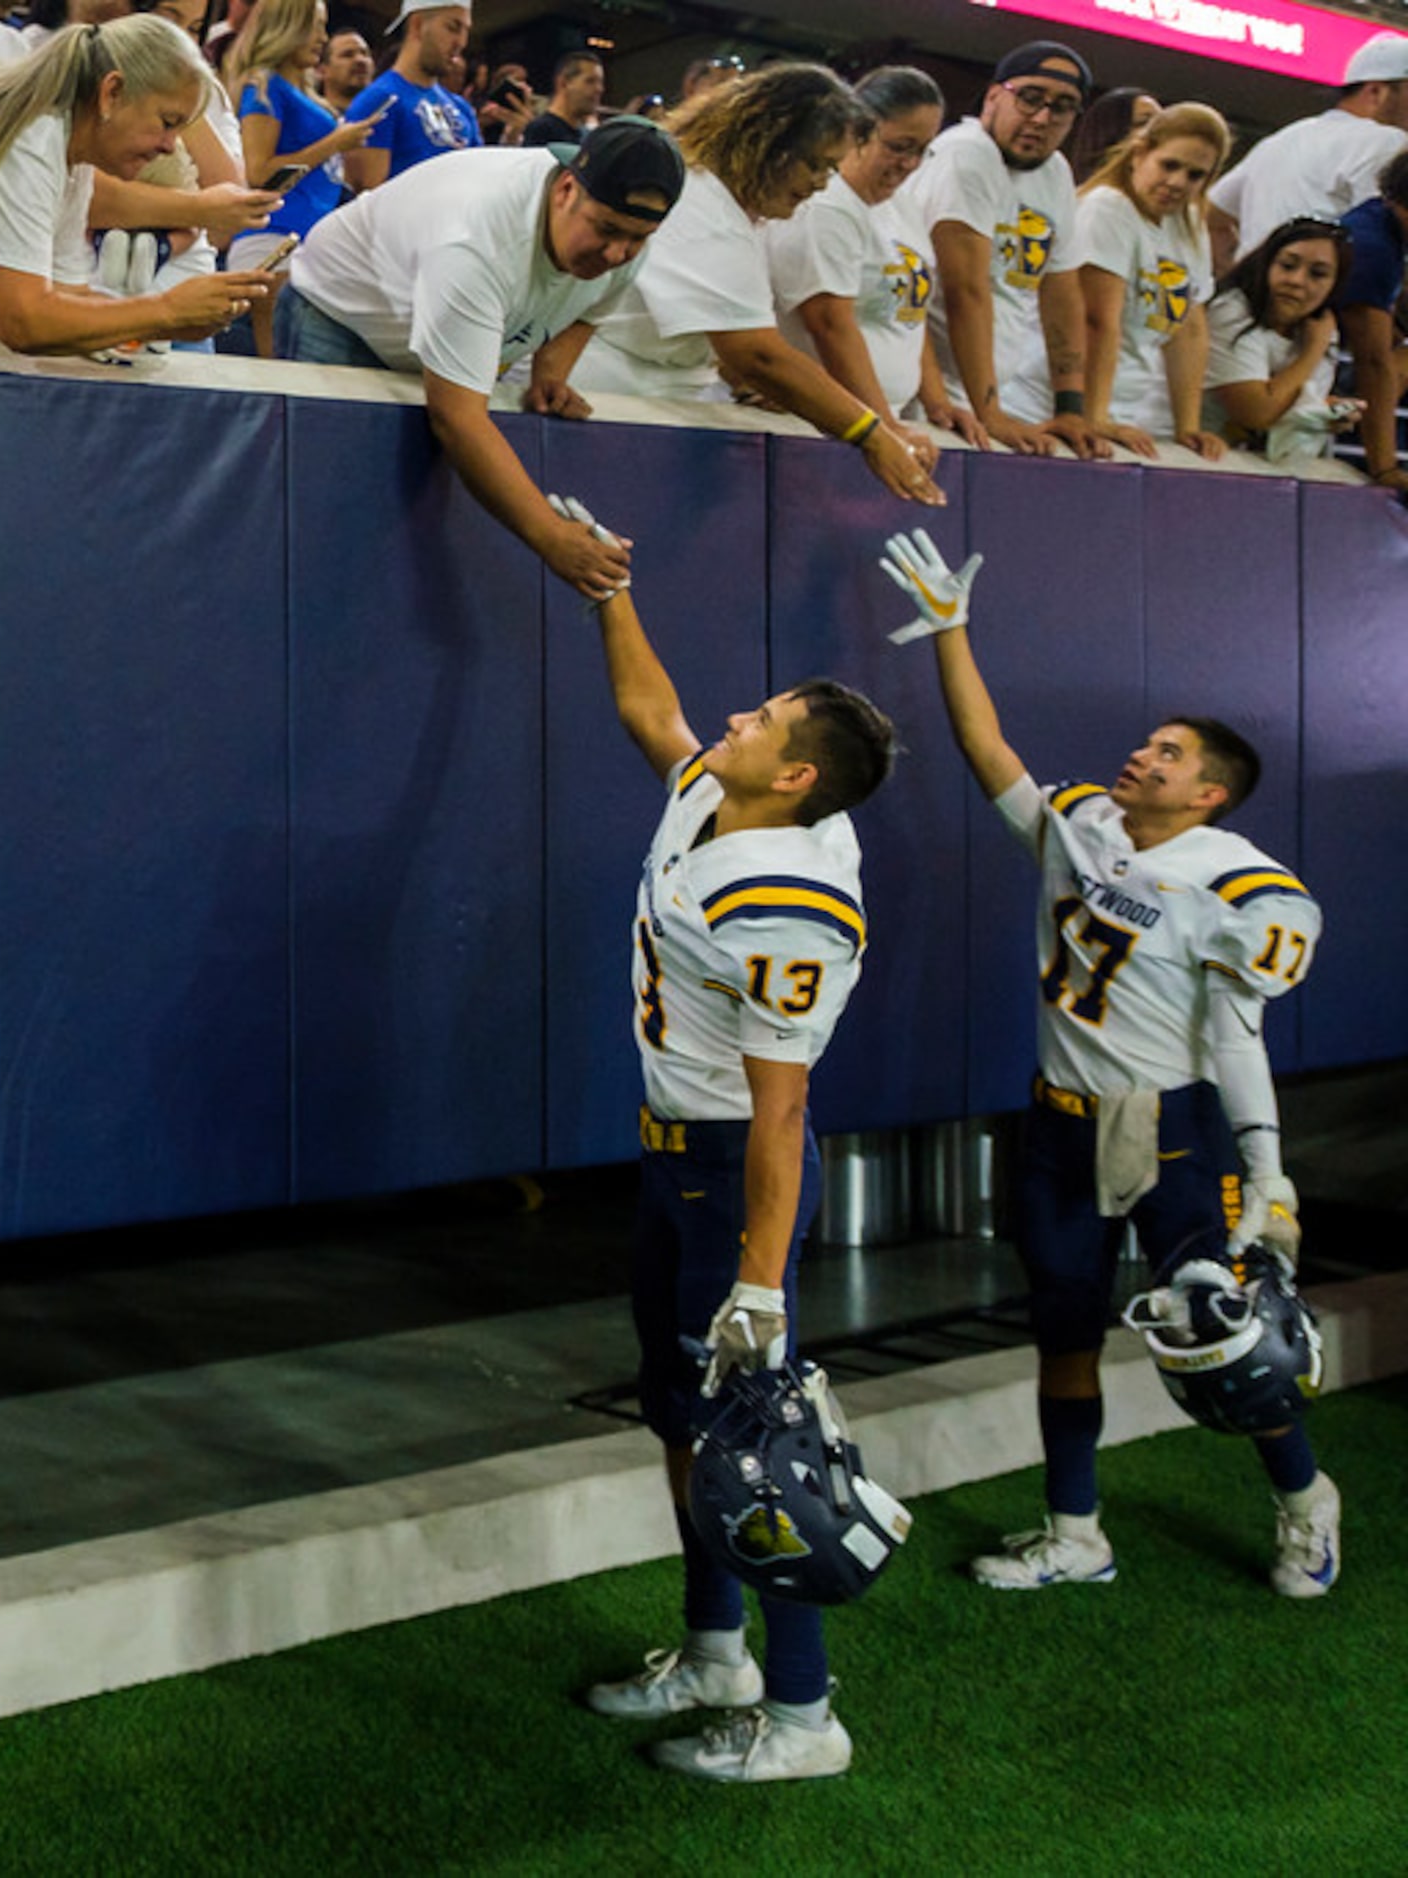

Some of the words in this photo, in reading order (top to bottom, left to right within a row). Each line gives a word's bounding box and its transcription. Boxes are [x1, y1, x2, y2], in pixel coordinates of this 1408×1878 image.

[745, 953, 824, 1017] 13
[1041, 894, 1140, 1028] 17
[1250, 922, 1308, 986] 17
